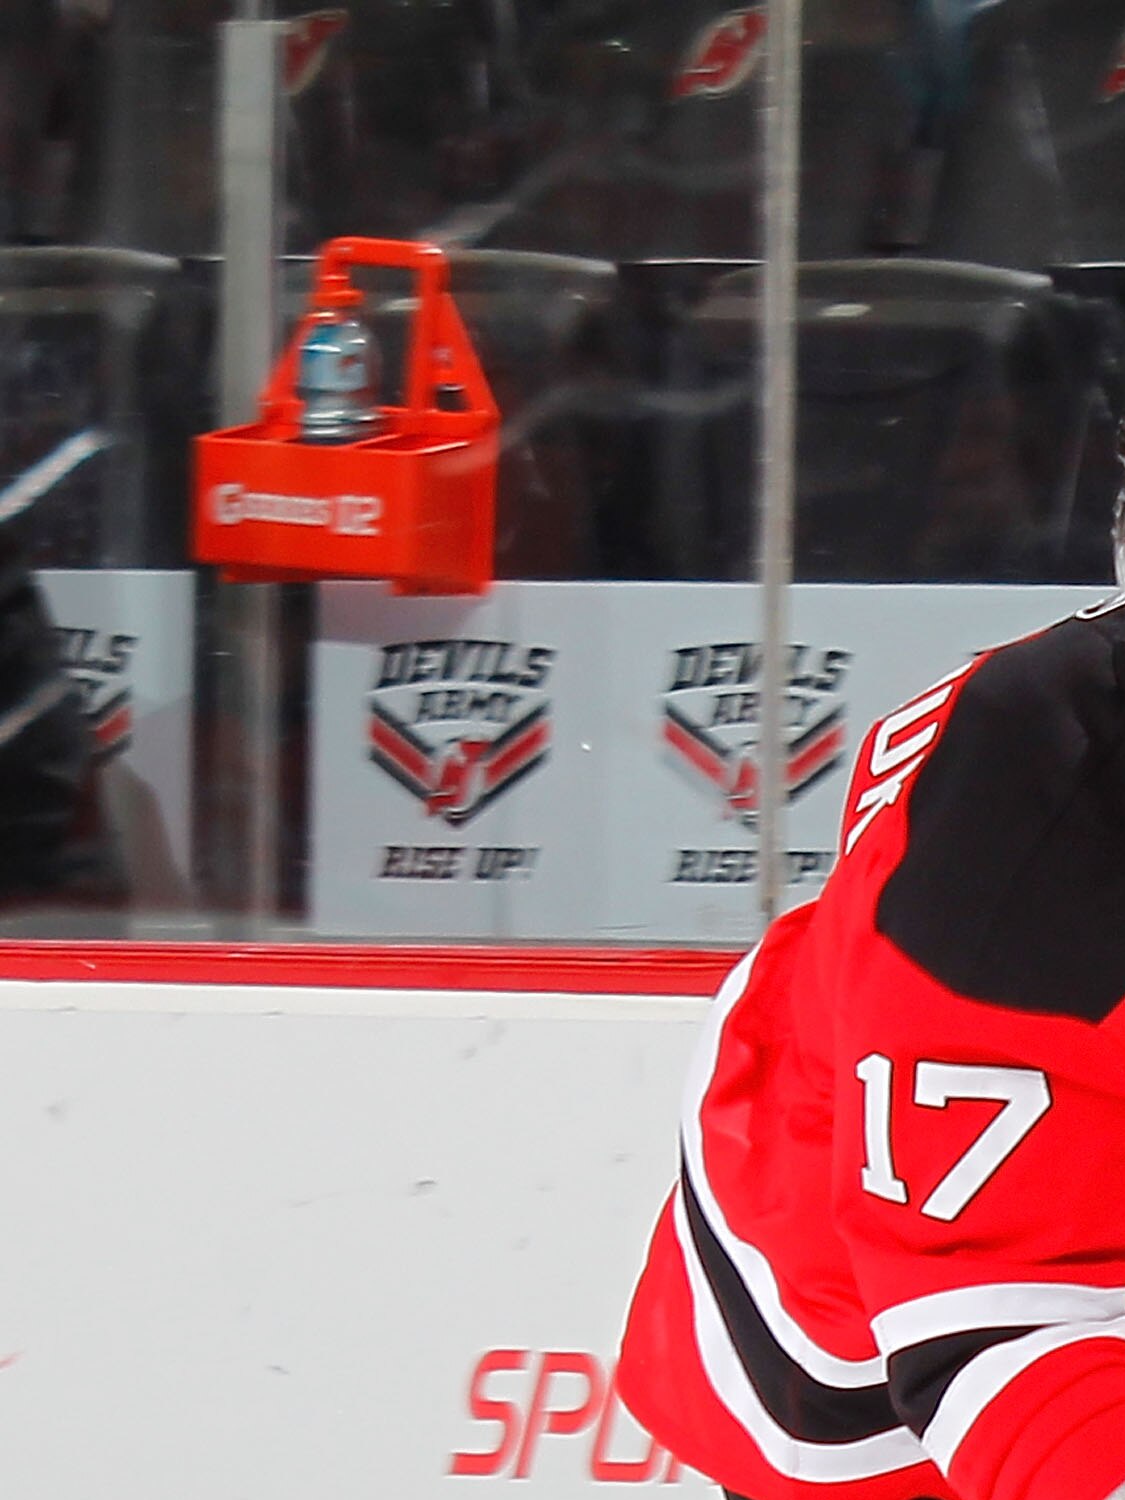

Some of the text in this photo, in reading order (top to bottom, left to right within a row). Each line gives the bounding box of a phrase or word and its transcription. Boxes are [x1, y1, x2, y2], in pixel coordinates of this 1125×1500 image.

[376, 639, 557, 689] DEVILS
[667, 642, 855, 693] DEVLS
[377, 846, 467, 879] RISE
[855, 1052, 1052, 1222] 17
